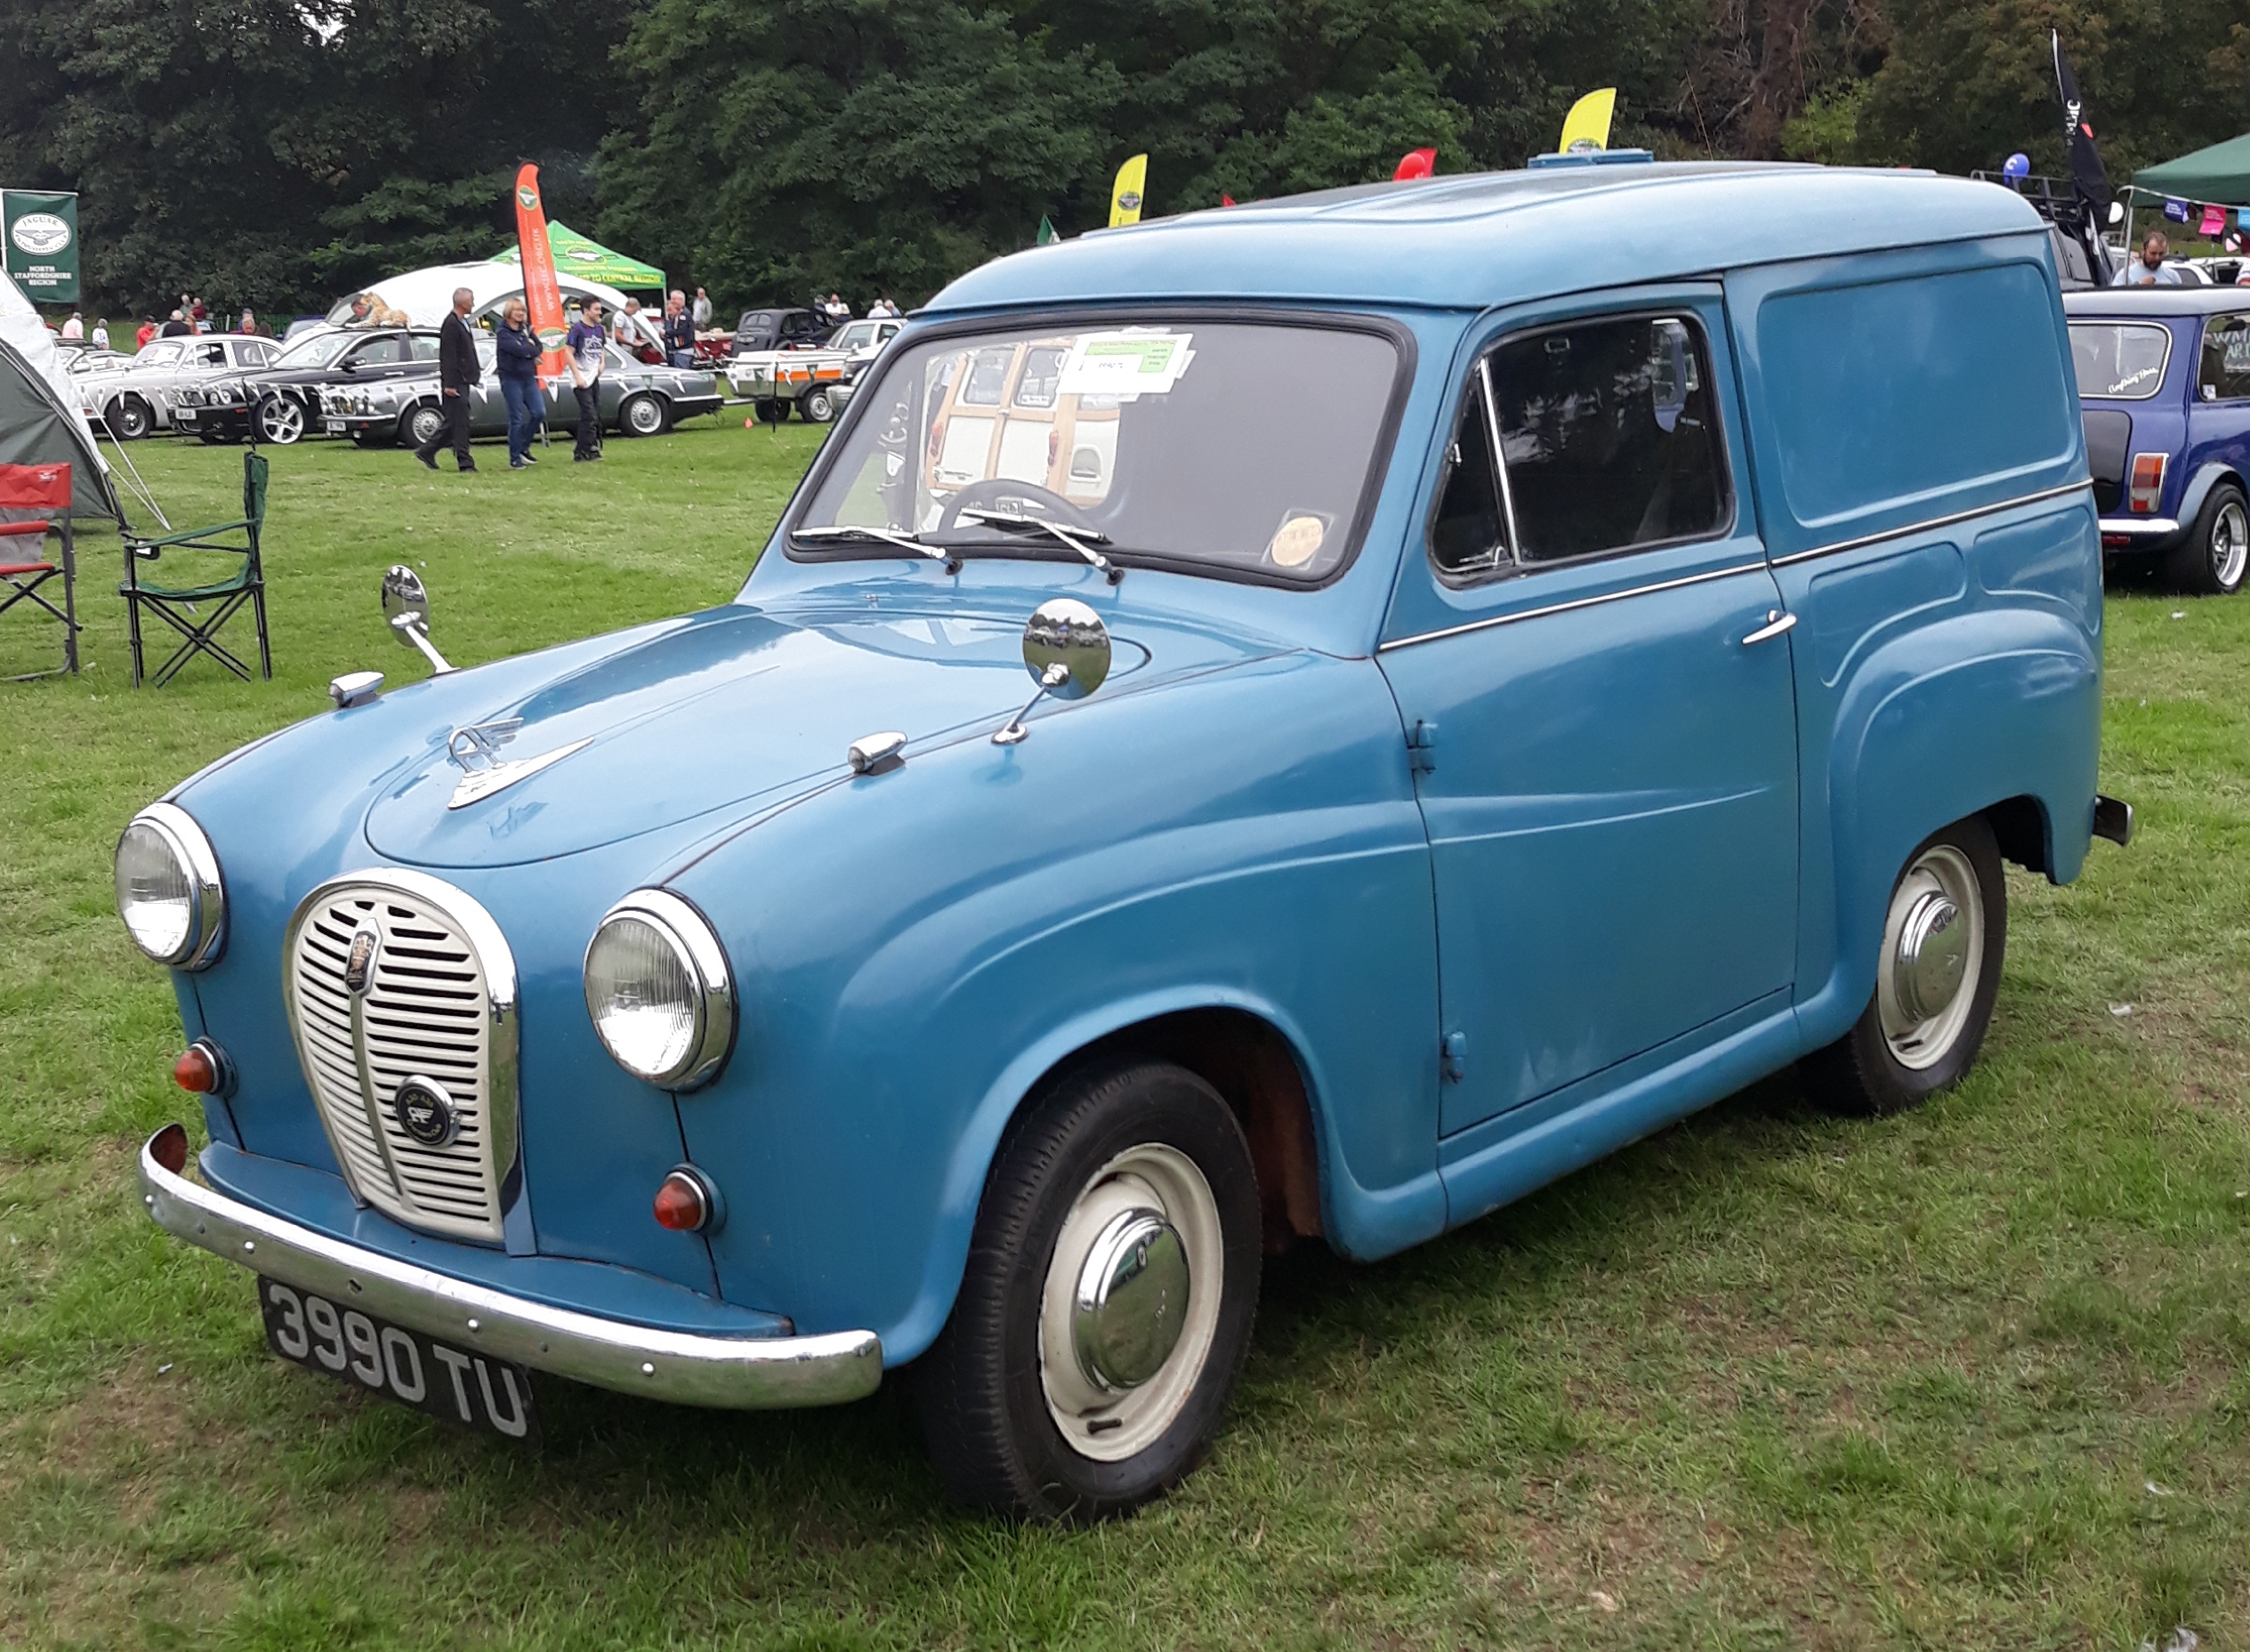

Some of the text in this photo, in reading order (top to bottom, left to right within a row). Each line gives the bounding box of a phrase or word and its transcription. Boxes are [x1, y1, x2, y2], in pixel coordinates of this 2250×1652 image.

[22, 216, 60, 228] JAGUAR
[270, 1284, 527, 1438] 3990 TU
